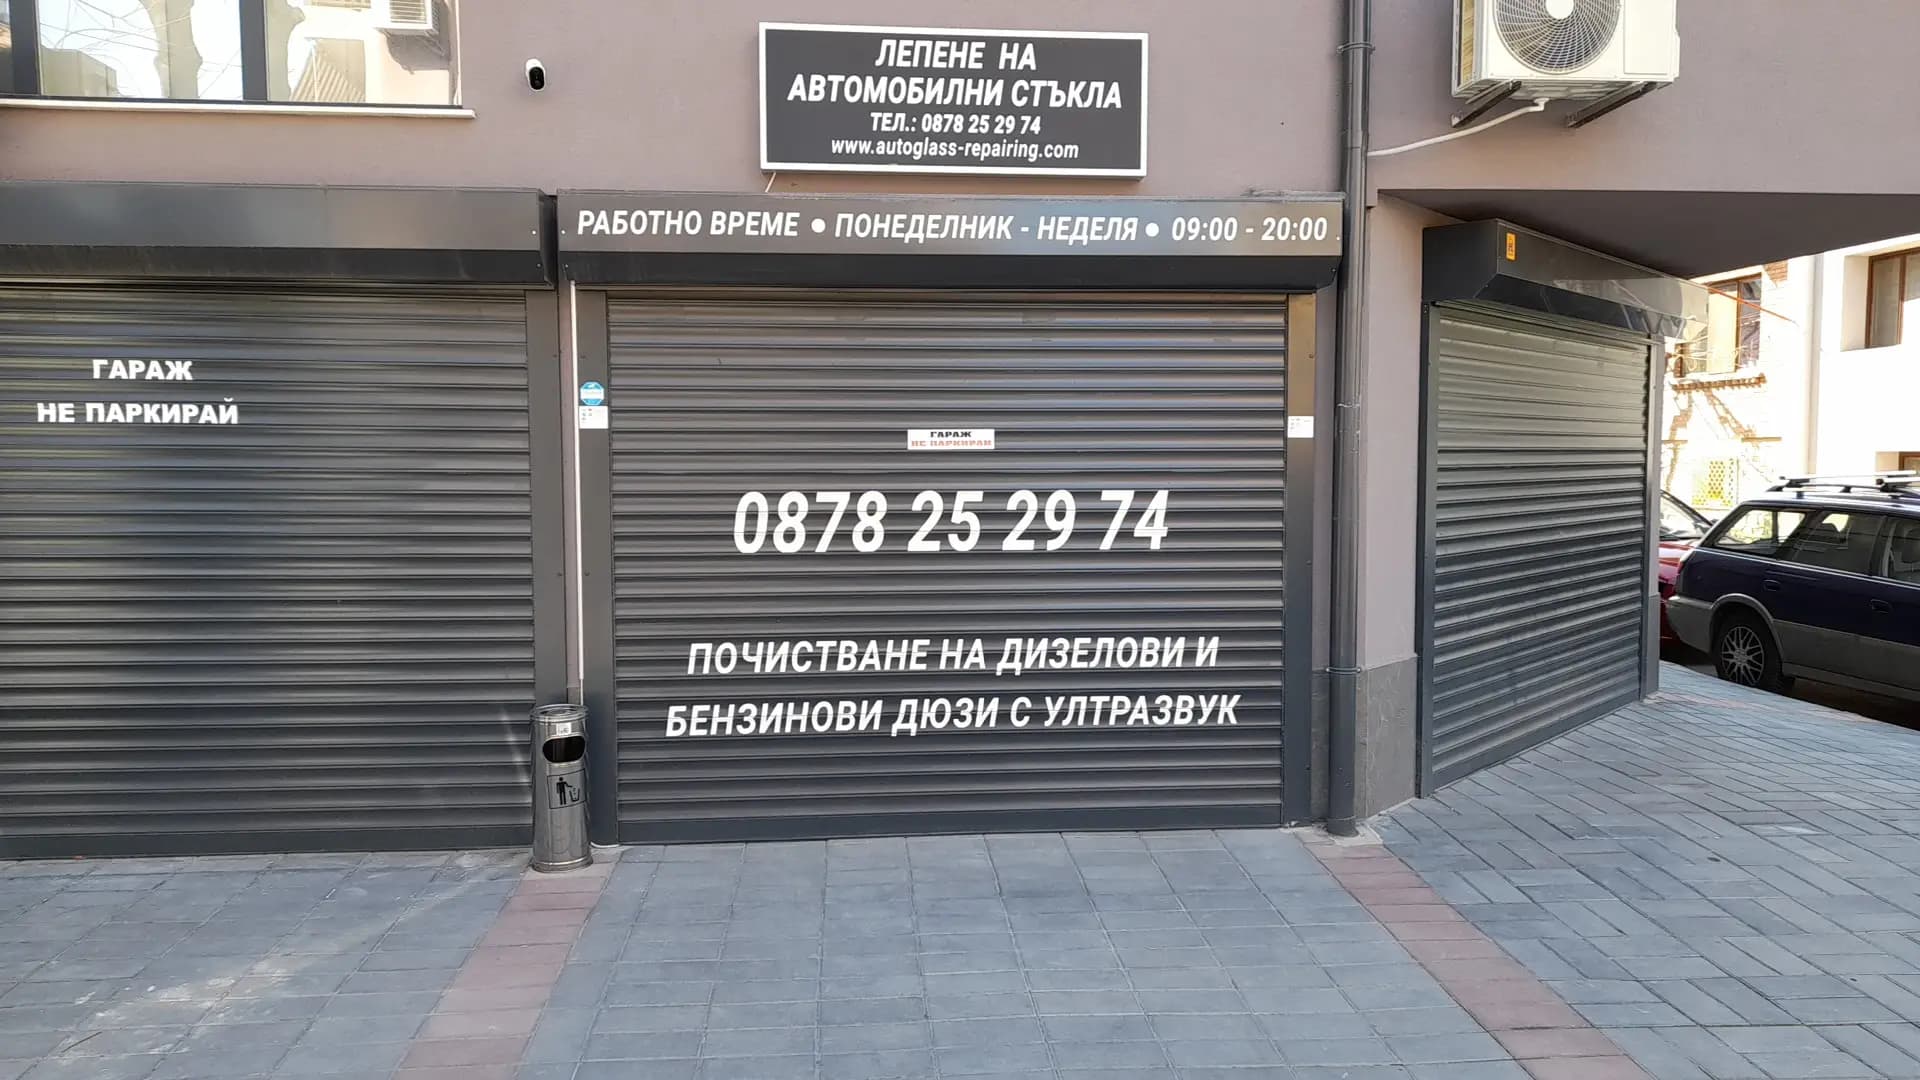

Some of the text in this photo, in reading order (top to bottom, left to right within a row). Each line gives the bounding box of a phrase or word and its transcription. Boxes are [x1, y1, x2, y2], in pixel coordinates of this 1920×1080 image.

[875, 39, 1037, 71] ЛЕПЕНЕ НА
[787, 74, 1123, 109] АВТОМОБИЛНИ СТЪКЛА
[870, 112, 1042, 135] ТЕЛ.: 0878 25 29 74
[831, 136, 1080, 163] www.autoglass-repairing.com
[577, 209, 702, 235] РАБОТНО
[709, 211, 800, 237] ВРЕМЕ
[834, 213, 1013, 244] ПОНЕДЕЛНИК
[1037, 215, 1138, 246] НЕДЕЛЯ
[1171, 216, 1238, 242] 09:00
[1261, 216, 1328, 242] 20:00
[92, 358, 193, 381] ГАРАЖ
[37, 397, 239, 425] НЕ ПАРКИРАЙ
[733, 489, 1170, 554] 0878 25 29 74
[687, 636, 1220, 676] ПОЧИСТВАНЕ НА ДИЗЕЛОВИ И
[665, 694, 1242, 737] БЕНЗИНОВИ ДЮЗИ С УЛТРАЗВУК
